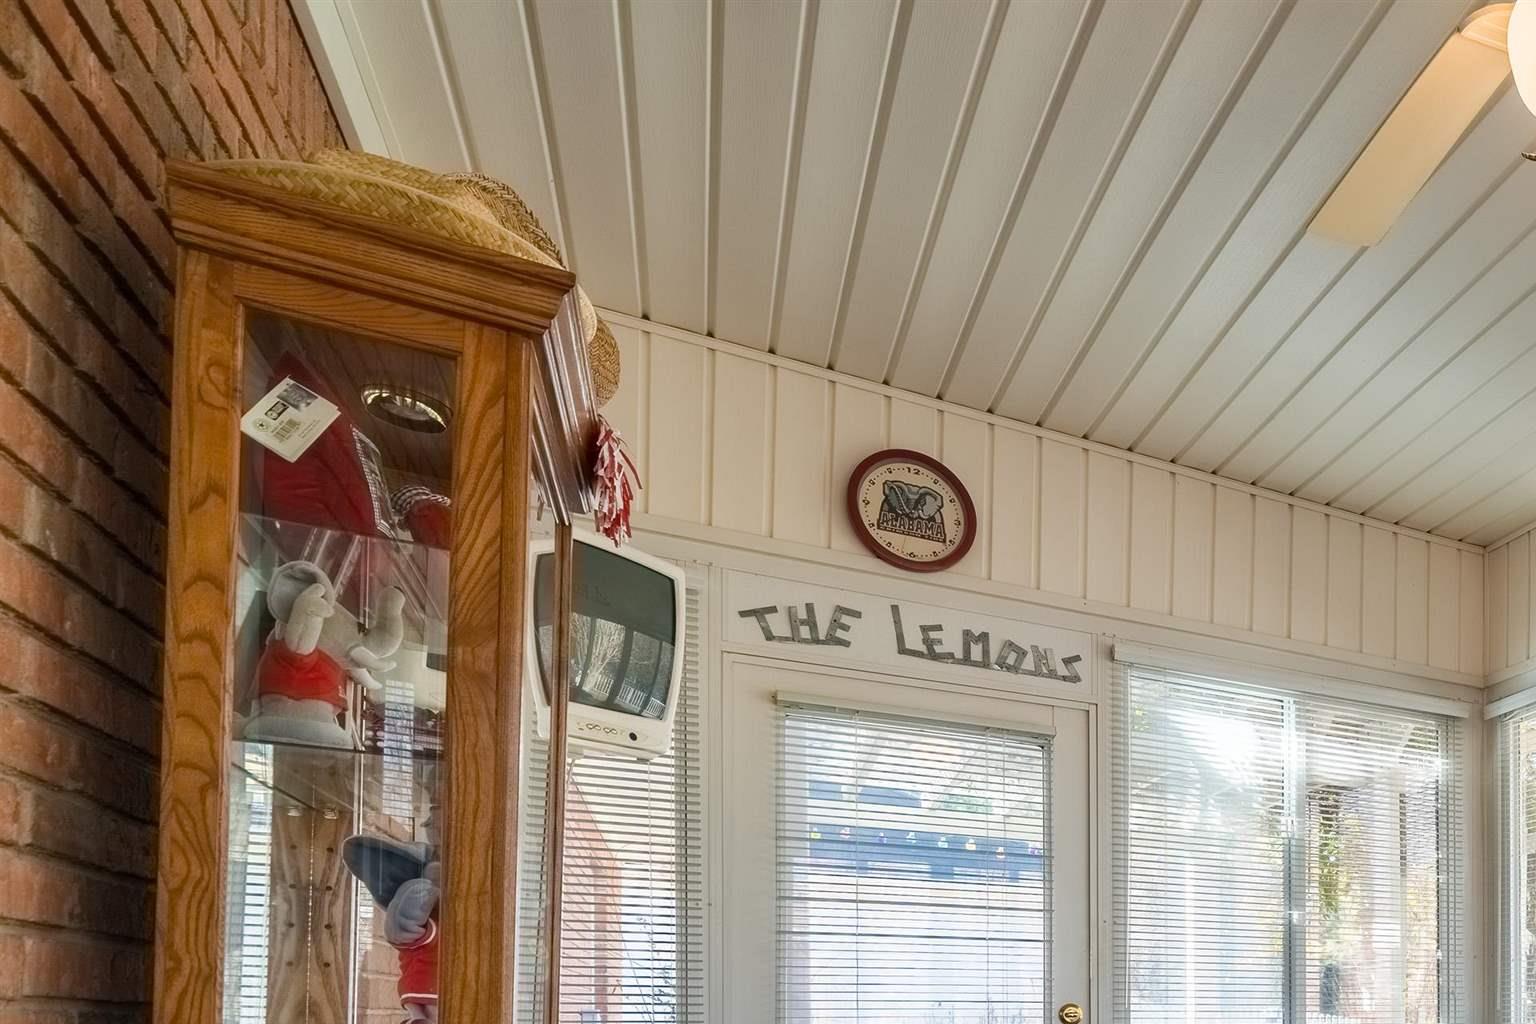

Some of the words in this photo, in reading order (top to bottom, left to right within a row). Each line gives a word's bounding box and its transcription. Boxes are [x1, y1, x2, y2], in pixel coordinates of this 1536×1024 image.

[906, 466, 921, 475] 12
[879, 511, 945, 539] ALABAMA
[738, 602, 862, 648] THE
[890, 604, 1083, 684] LEMONS
